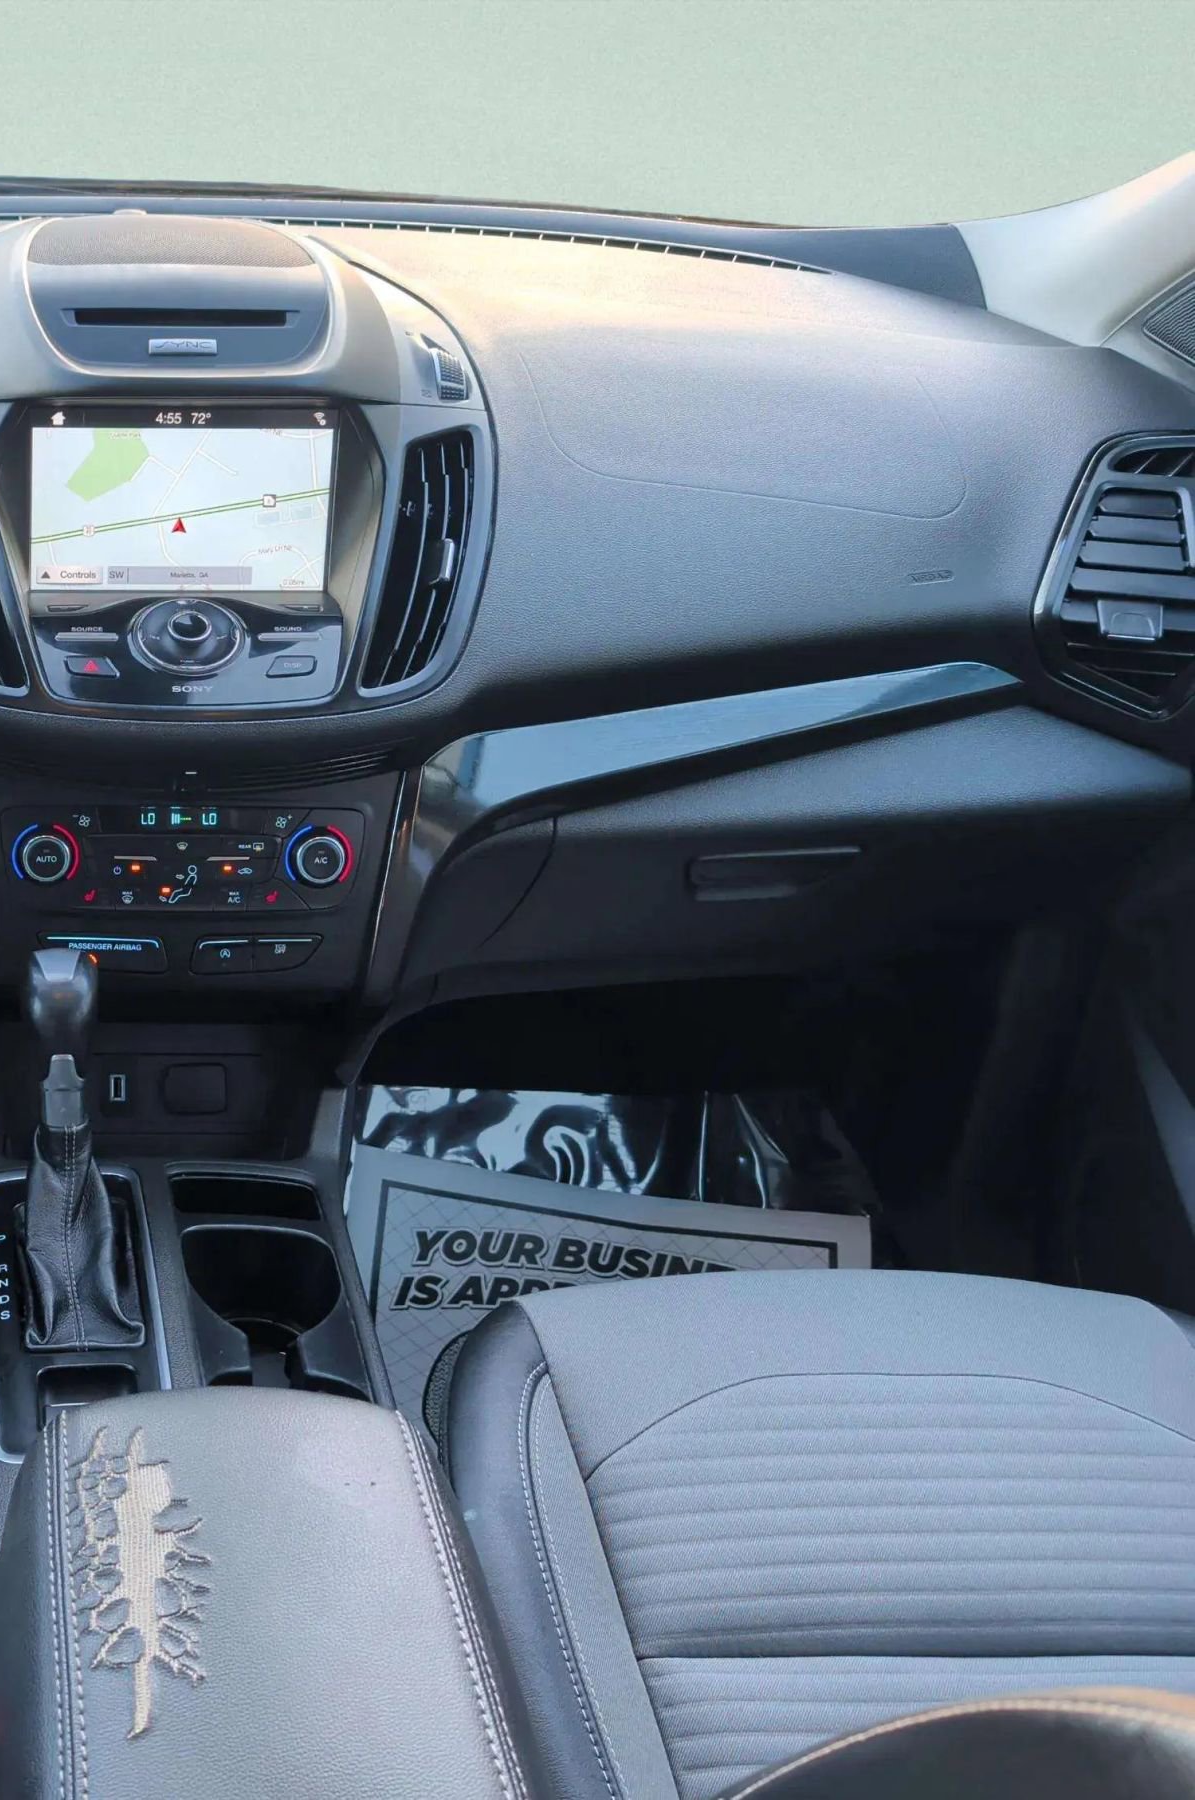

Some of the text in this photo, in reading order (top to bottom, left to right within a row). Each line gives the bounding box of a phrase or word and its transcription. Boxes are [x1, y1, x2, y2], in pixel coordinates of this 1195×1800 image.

[155, 412, 182, 425] 4:55
[190, 412, 212, 425] 72°
[60, 570, 96, 579] Controls
[108, 570, 124, 579] SW
[172, 685, 213, 693] SONY
[140, 812, 156, 825] LO
[202, 812, 217, 825] LO
[35, 855, 58, 863] AUTO
[314, 856, 329, 864] A/C
[227, 896, 241, 904] A/C
[68, 942, 142, 951] PASSENGER AIRBAG
[413, 1229, 738, 1279] YOUR BUSIN
[392, 1274, 445, 1307] IS
[0, 1295, 10, 1304] D
[0, 1310, 11, 1320] S
